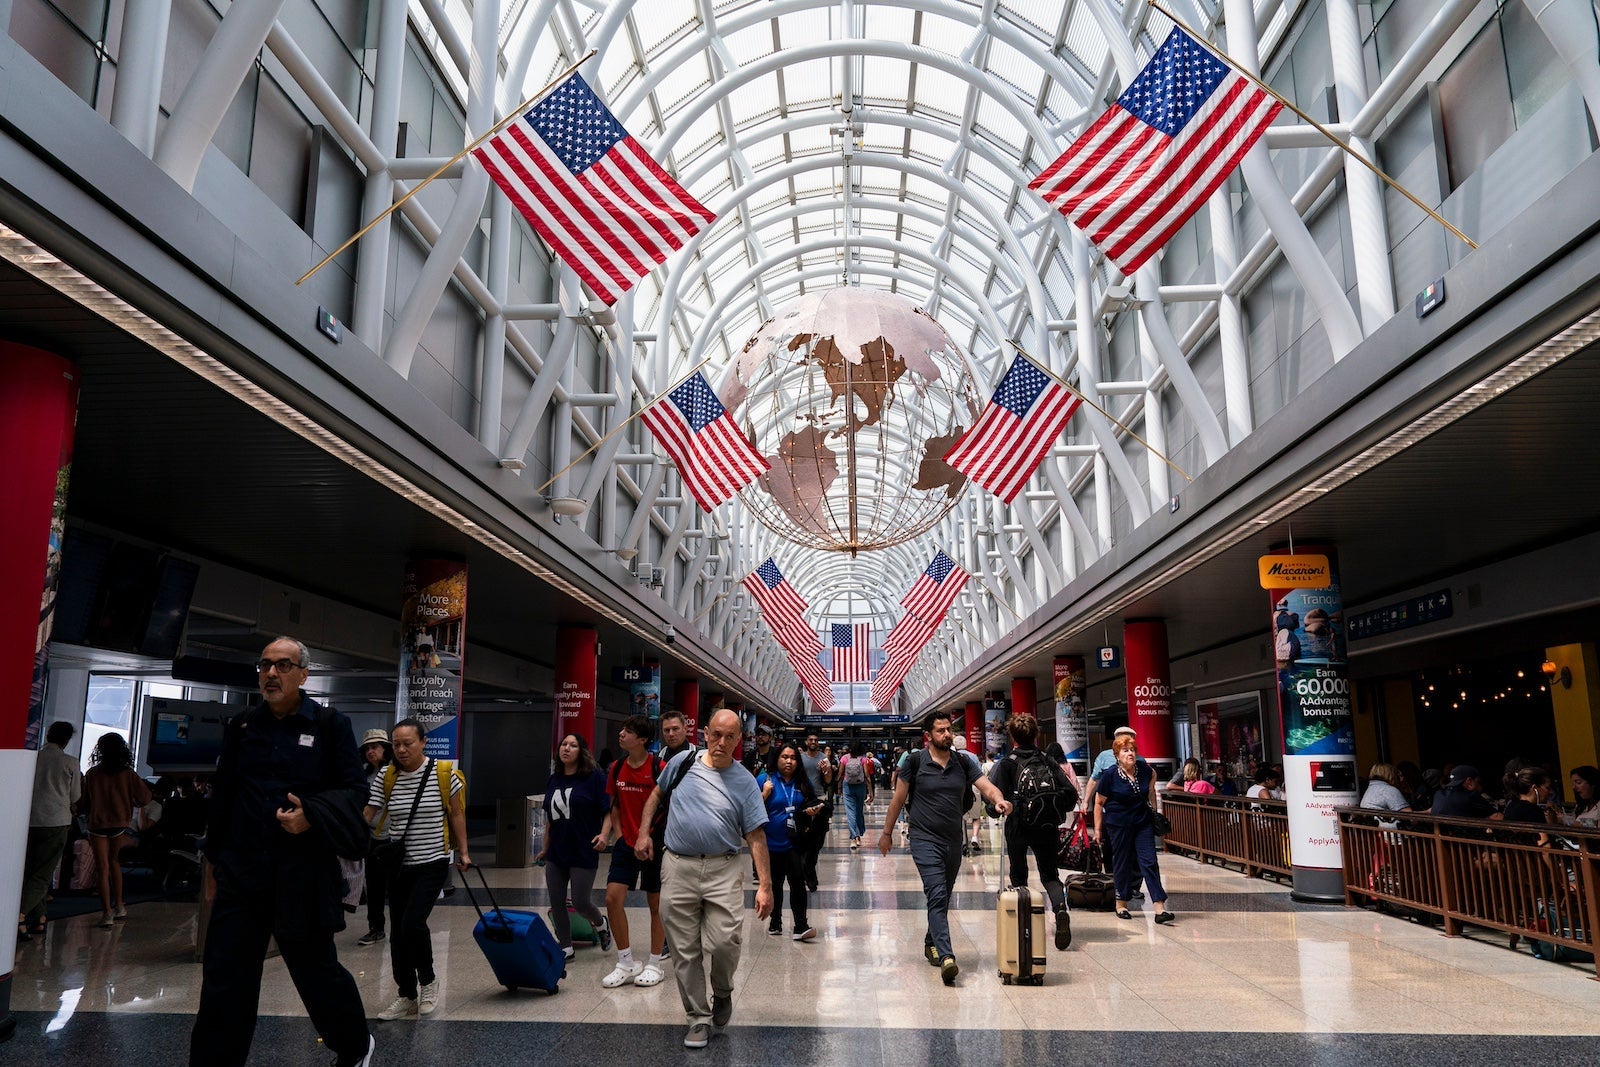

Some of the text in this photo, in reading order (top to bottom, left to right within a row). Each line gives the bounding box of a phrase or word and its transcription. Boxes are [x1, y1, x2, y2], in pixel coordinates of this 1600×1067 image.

[1268, 562, 1326, 575] Macaroni
[419, 593, 449, 604] More
[1418, 599, 1434, 612] H K
[624, 670, 639, 680] H3
[1316, 668, 1336, 677] Earn
[412, 675, 447, 688] Loyalty
[562, 681, 578, 689] Earn
[409, 687, 428, 697] and
[429, 688, 453, 698] reach
[1134, 685, 1171, 698] 60,000
[1296, 678, 1350, 697] 60,000
[571, 691, 591, 699] Points
[559, 700, 581, 708] toward
[993, 700, 1006, 709] K2
[1303, 707, 1332, 716] bonus
[415, 713, 443, 723] faster
[550, 787, 573, 821] N
[1308, 837, 1341, 846] ApplyAv
